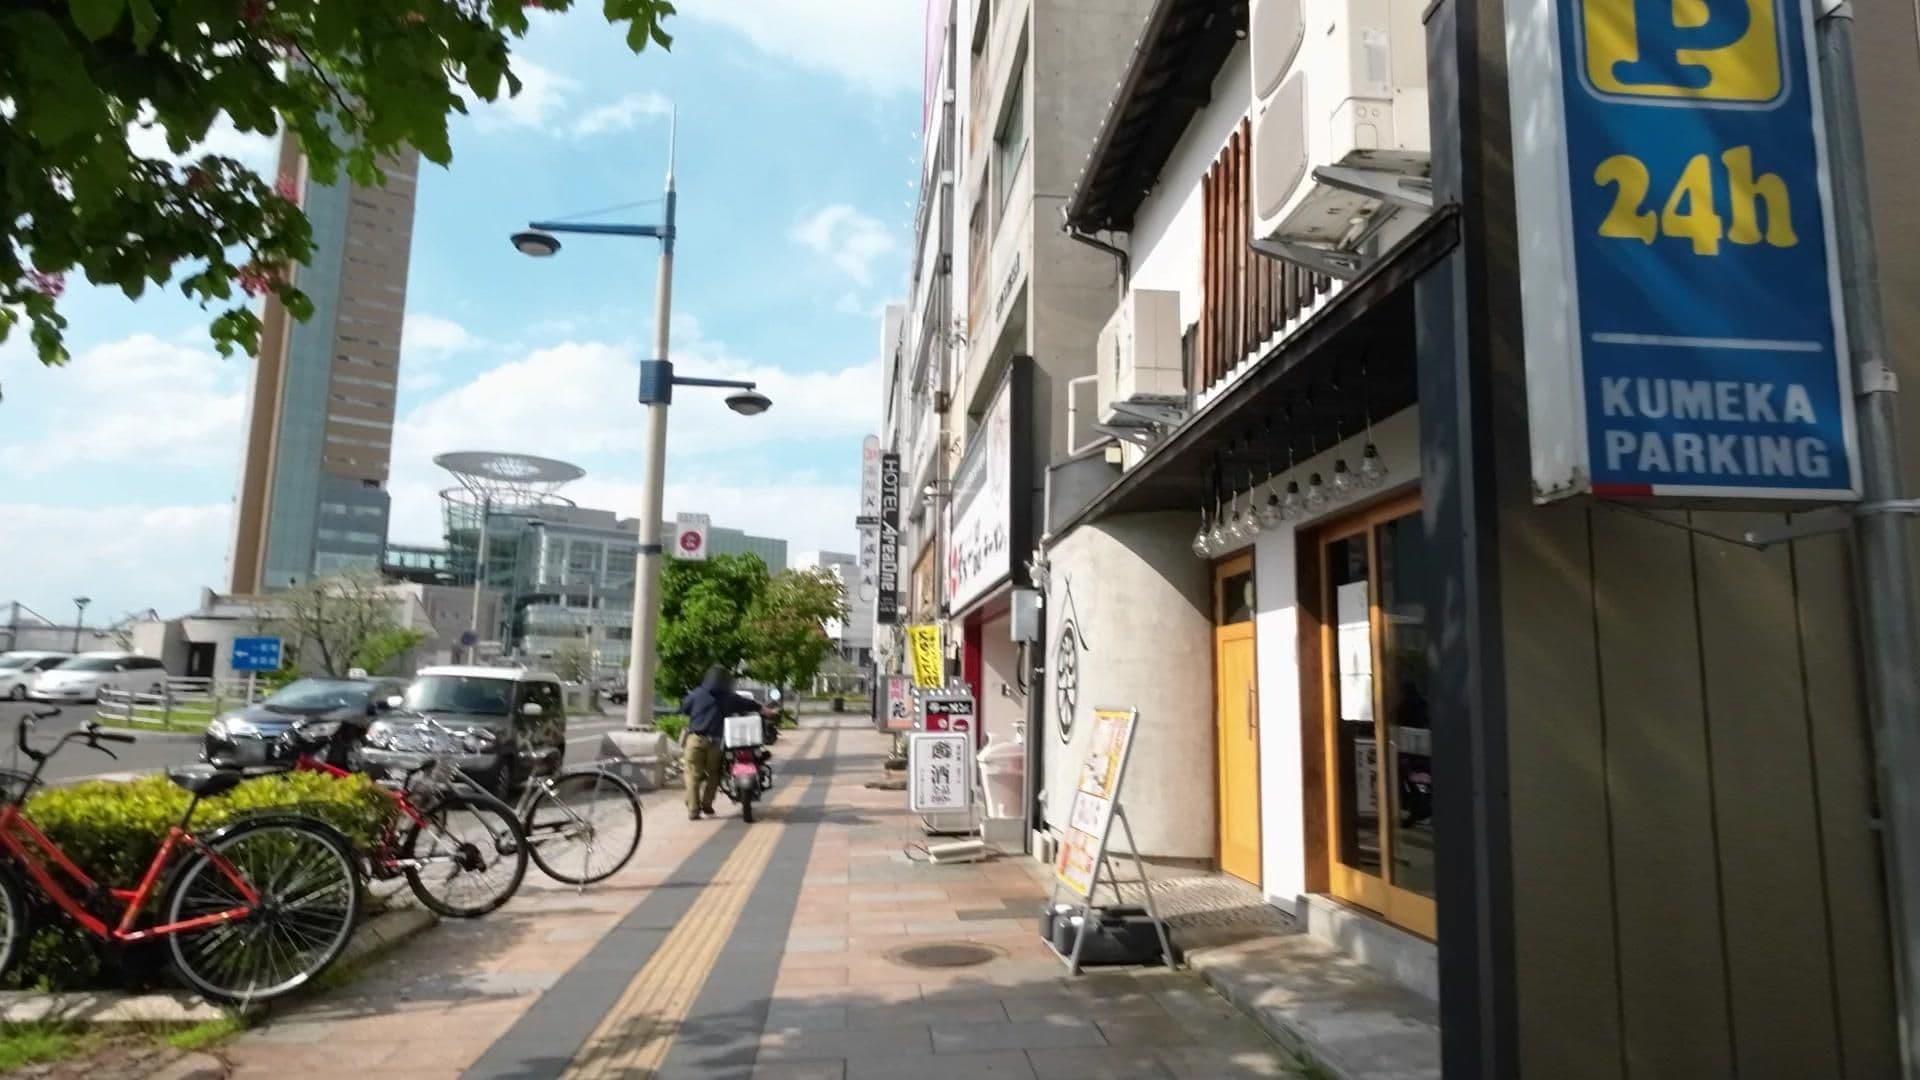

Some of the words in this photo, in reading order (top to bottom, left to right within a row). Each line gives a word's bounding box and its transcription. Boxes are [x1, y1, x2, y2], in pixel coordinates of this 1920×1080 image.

[1594, 145, 1799, 255] 24h
[1601, 377, 1816, 424] KUMEKA
[1605, 431, 1830, 477] PARKING
[883, 459, 898, 518] HOTEL
